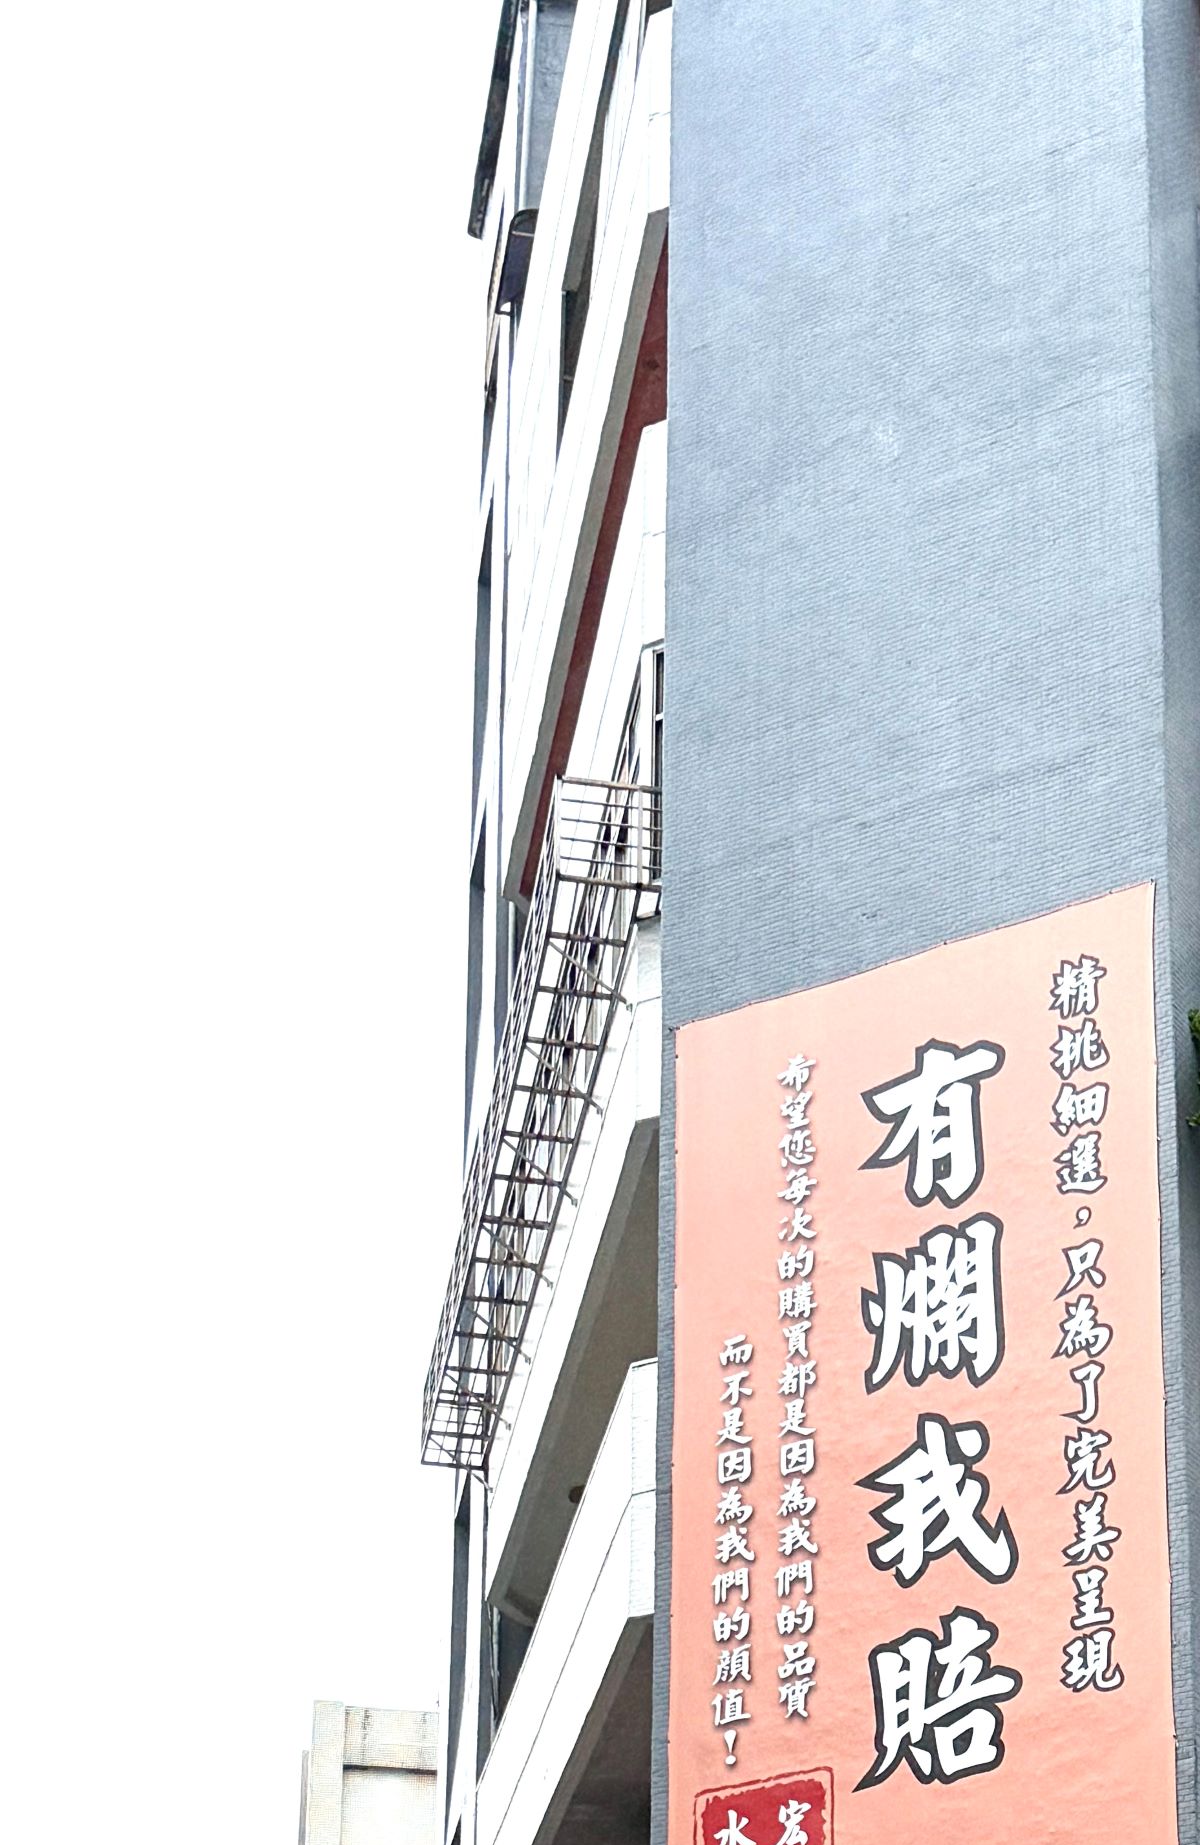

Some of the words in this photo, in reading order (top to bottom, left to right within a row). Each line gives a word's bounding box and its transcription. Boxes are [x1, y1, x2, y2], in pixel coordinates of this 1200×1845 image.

[776, 1053, 819, 1720] 希望您每次的購買都是因為我們的品質
[853, 1037, 1022, 1792] 有爛我賠
